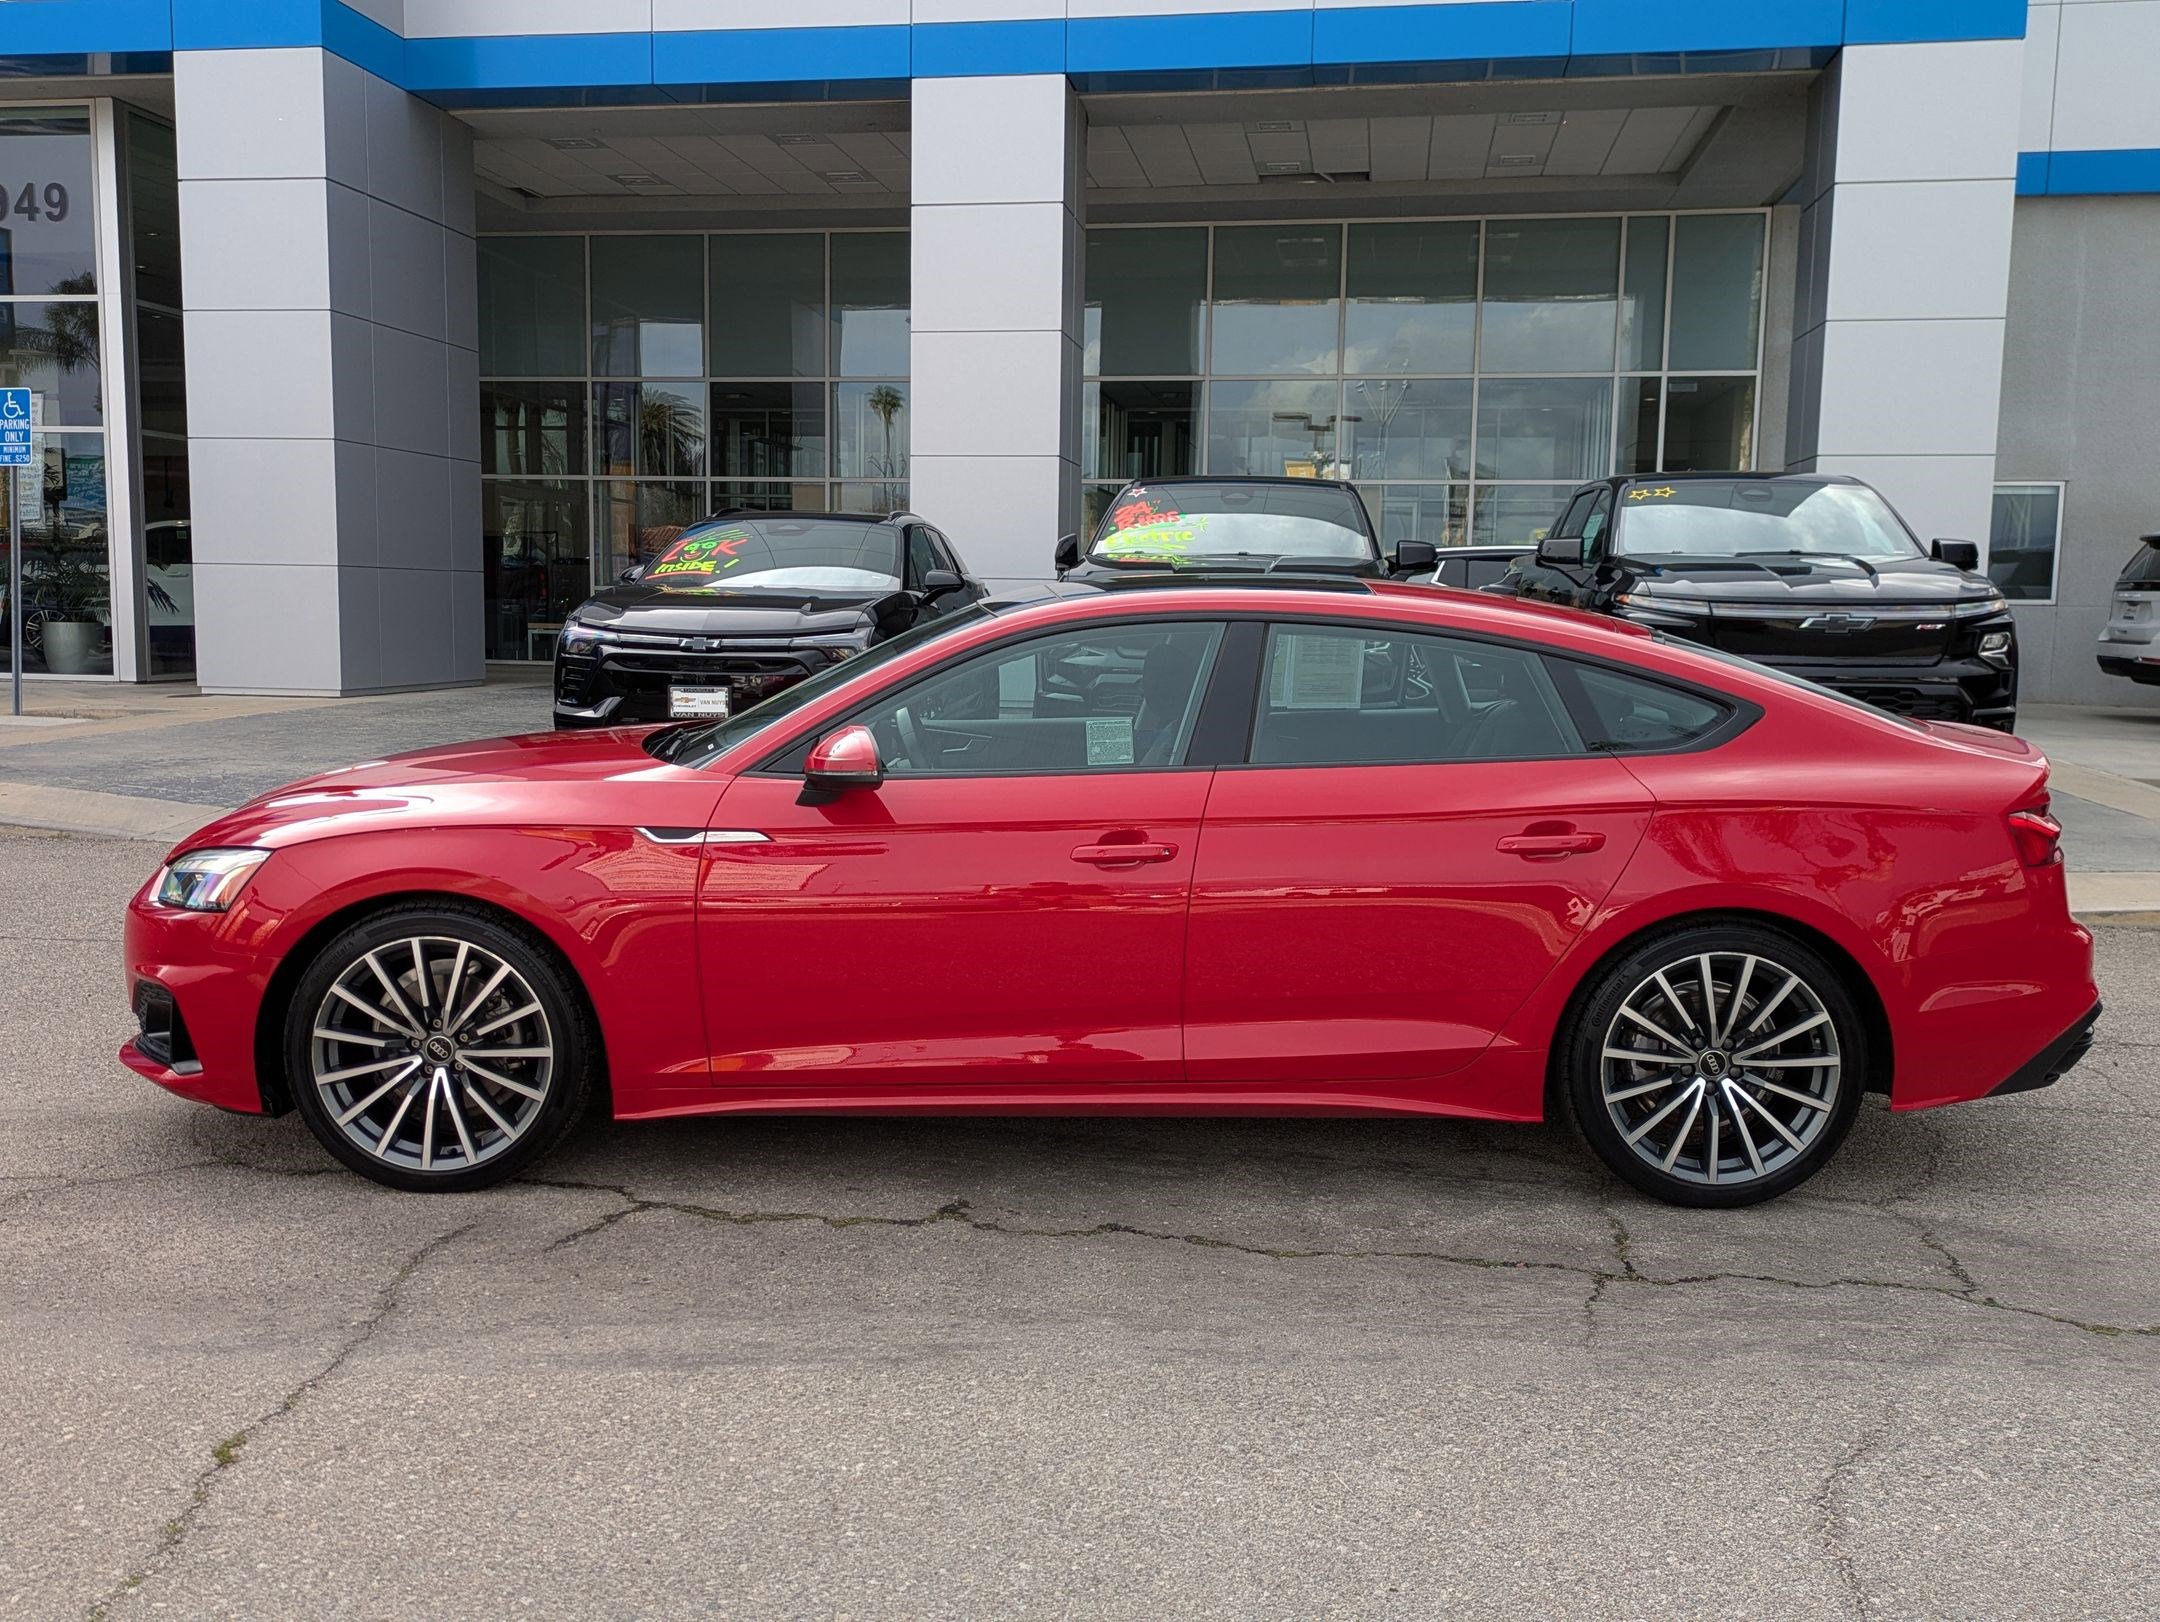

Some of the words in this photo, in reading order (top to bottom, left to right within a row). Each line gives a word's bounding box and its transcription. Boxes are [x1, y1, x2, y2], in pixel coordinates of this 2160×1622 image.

[0, 419, 30, 430] PARKING
[4, 431, 24, 442] ONLY
[15, 455, 30, 463] $250
